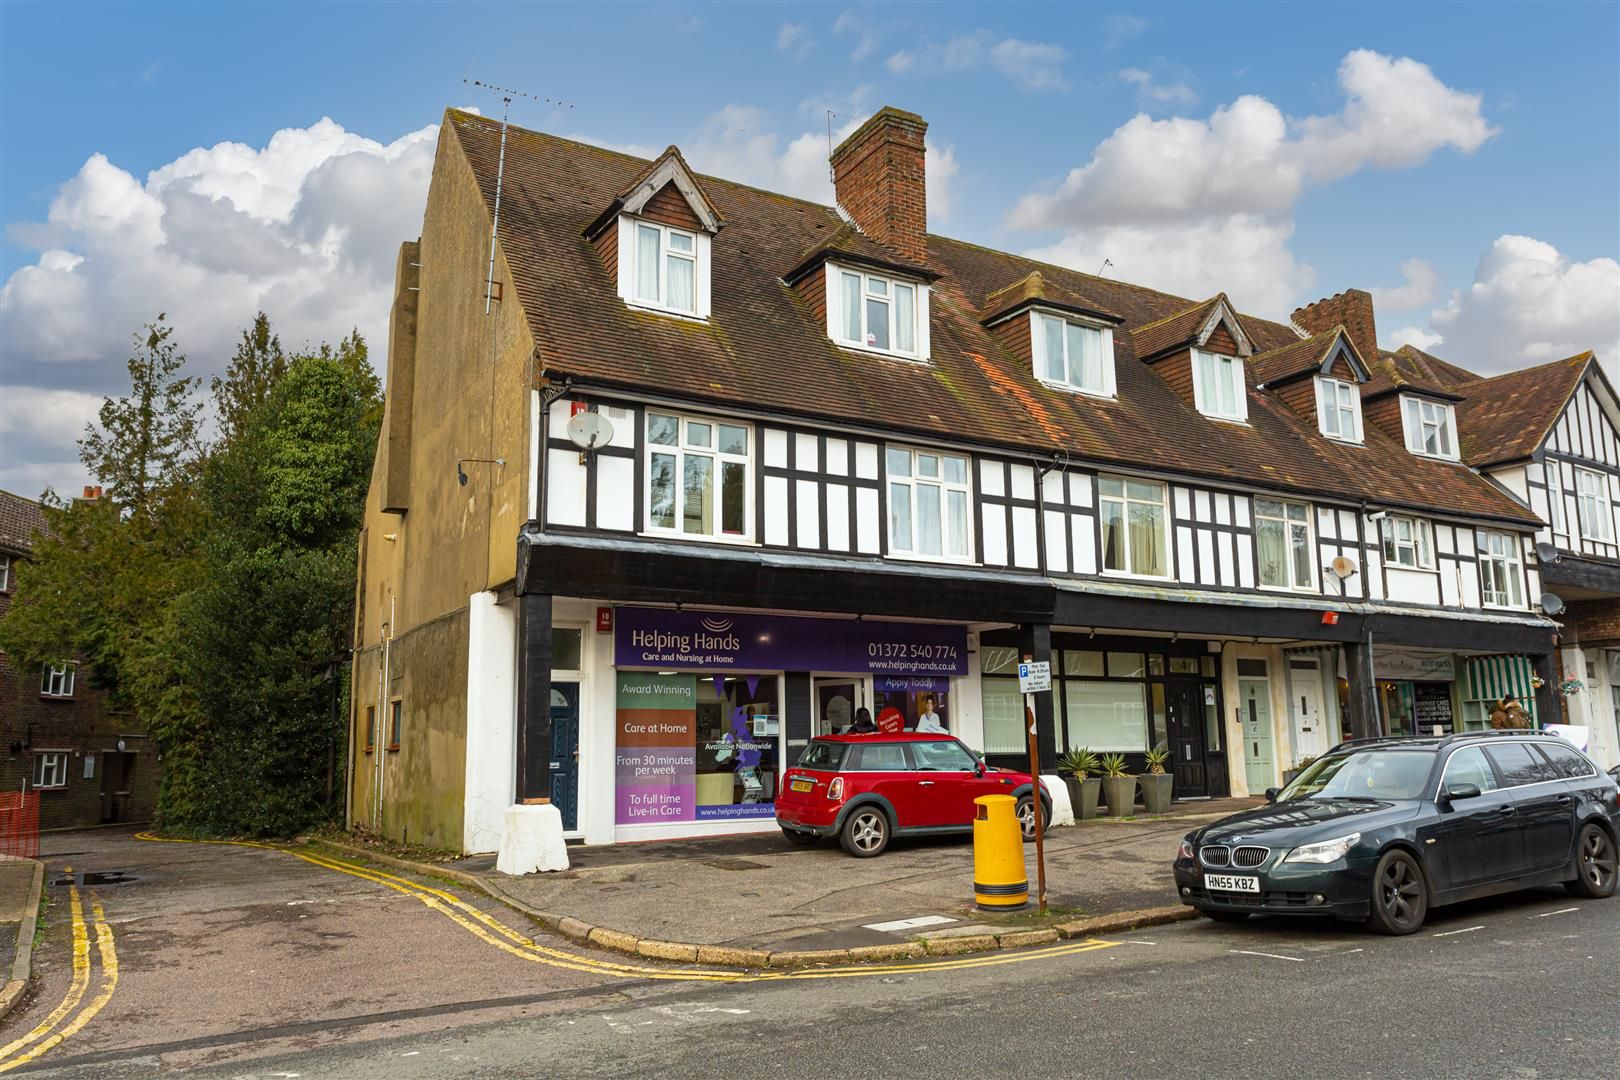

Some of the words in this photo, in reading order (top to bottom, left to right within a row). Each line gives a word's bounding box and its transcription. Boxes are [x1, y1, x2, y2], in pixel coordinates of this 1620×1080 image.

[632, 629, 691, 653] Helping
[694, 633, 740, 651] Hands
[868, 643, 907, 658] 01372
[910, 644, 932, 659] 540
[935, 645, 957, 660] 774
[642, 652, 660, 661] Care
[661, 653, 675, 662] and
[676, 653, 704, 664] Nursing
[705, 655, 712, 663] at
[713, 655, 734, 663] Home
[868, 660, 957, 672] www.helpinghands.co.uk
[886, 678, 908, 688] Apply
[622, 684, 651, 694] Award
[653, 685, 691, 697] Winning
[624, 723, 646, 733] Care
[648, 724, 658, 733] at
[660, 723, 687, 734] Home
[705, 743, 735, 751] Available
[736, 743, 772, 751] Nationwide
[617, 756, 641, 766] From
[643, 756, 657, 766] 30
[657, 755, 694, 765] minutes
[635, 767, 650, 777] per
[652, 765, 676, 775] week
[629, 795, 641, 804] To
[643, 794, 657, 804] full
[659, 794, 681, 804] time
[628, 806, 658, 816] Live-in
[661, 806, 682, 816] Care
[701, 806, 775, 816] www.helpinghands.co.uk
[1208, 875, 1233, 889] HN55
[1234, 877, 1255, 890] KBZ
